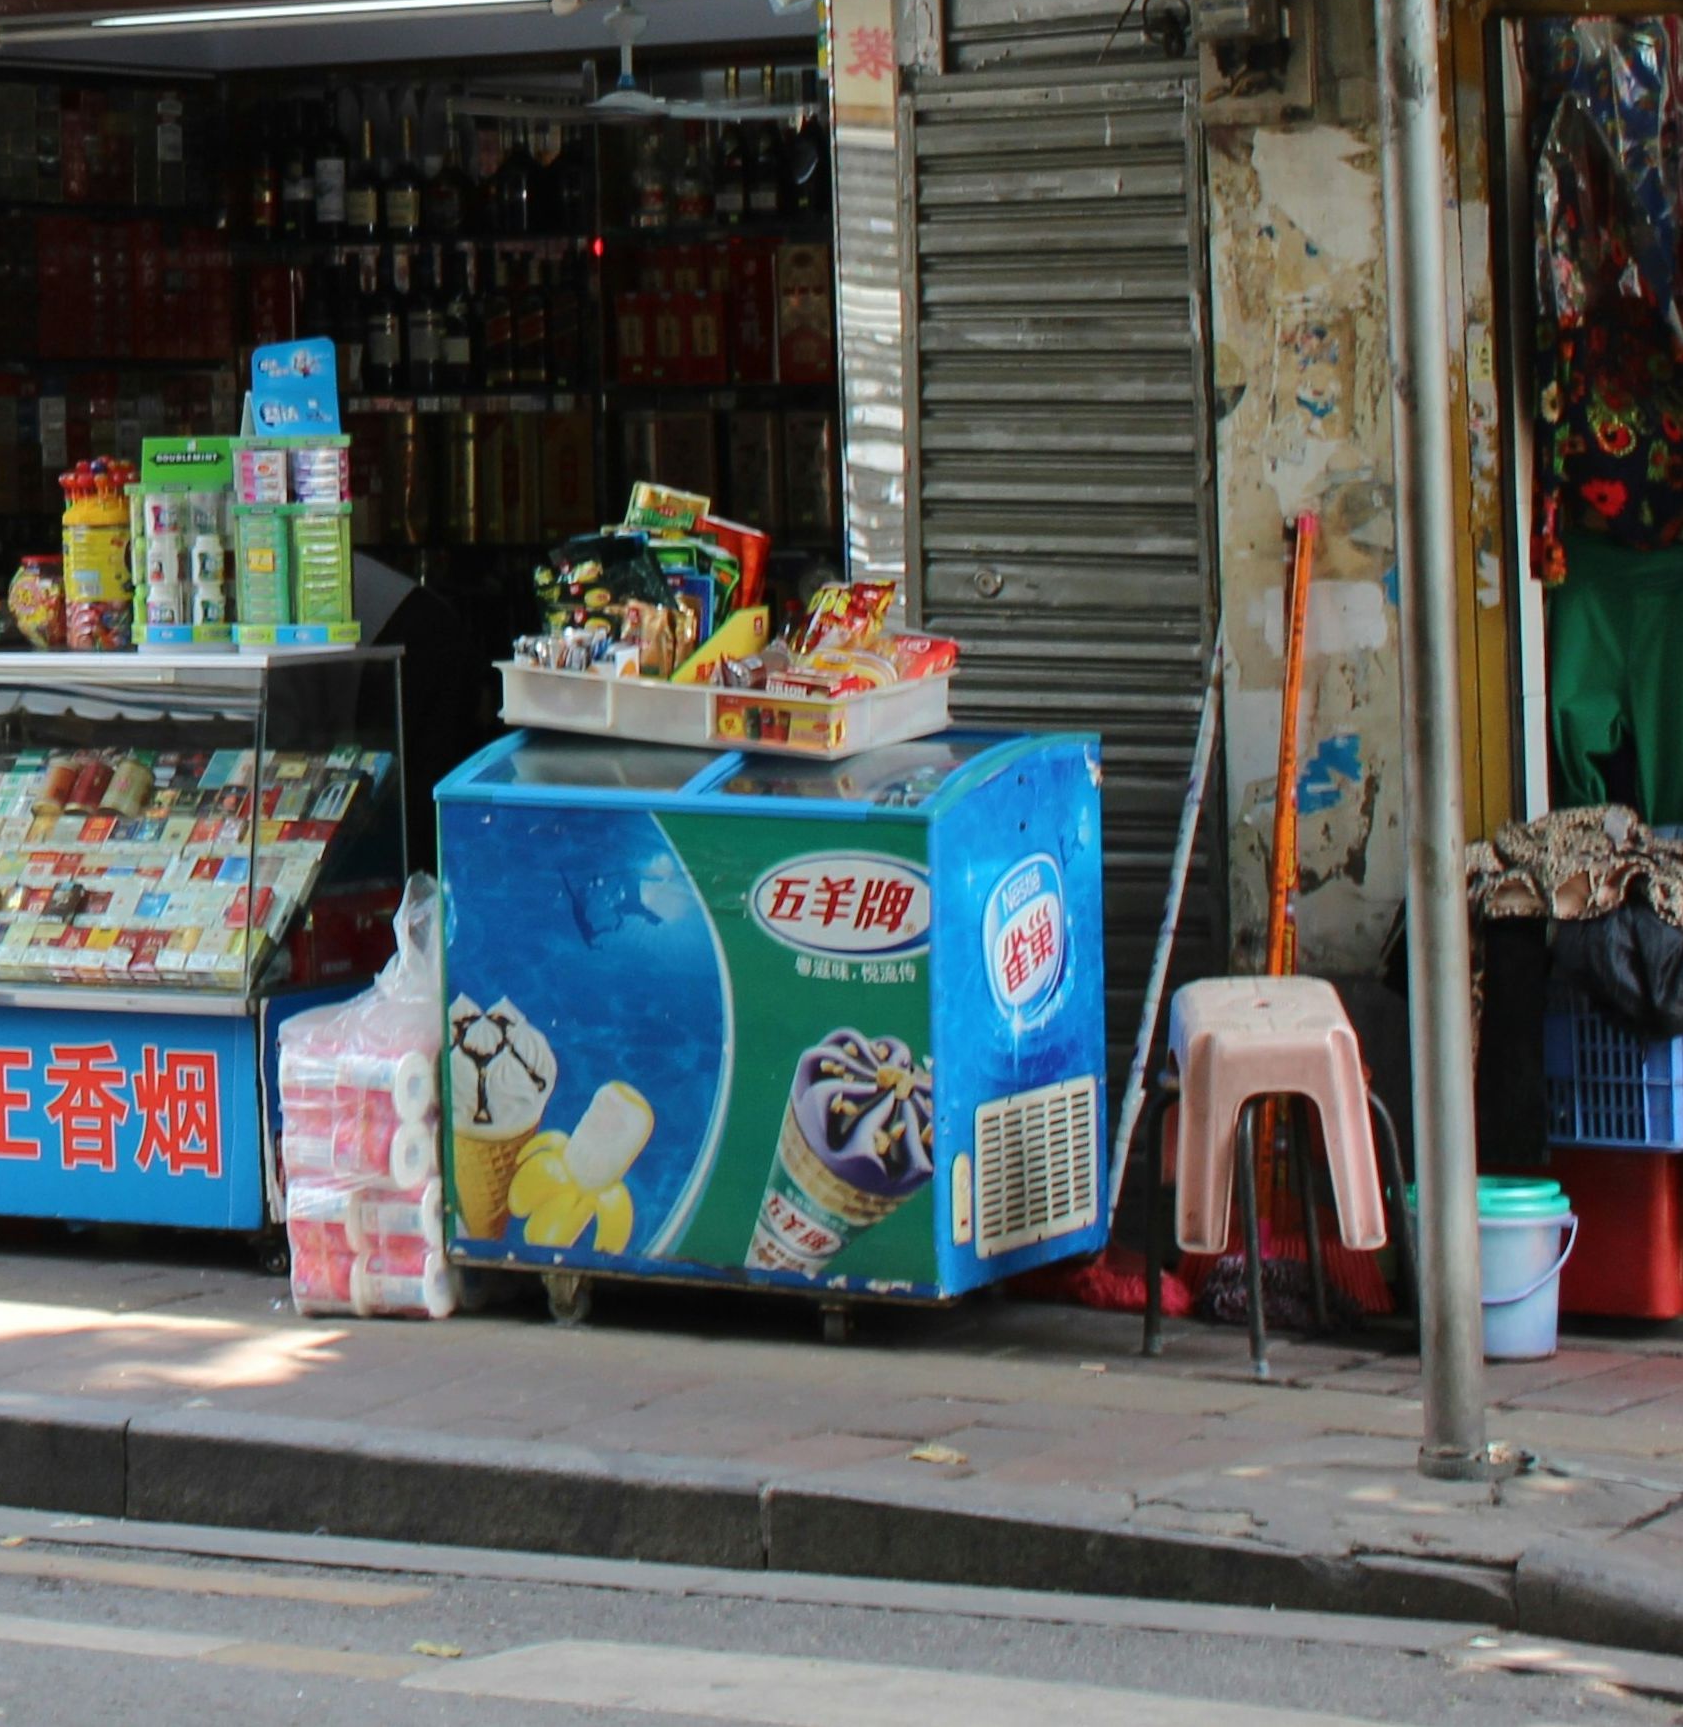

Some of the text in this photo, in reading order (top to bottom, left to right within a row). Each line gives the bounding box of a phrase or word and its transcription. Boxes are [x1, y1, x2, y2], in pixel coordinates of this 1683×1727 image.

[154, 451, 219, 464] DOUBLEMINT
[767, 874, 916, 934] 五羊牌
[1002, 901, 1056, 995] 雀巢
